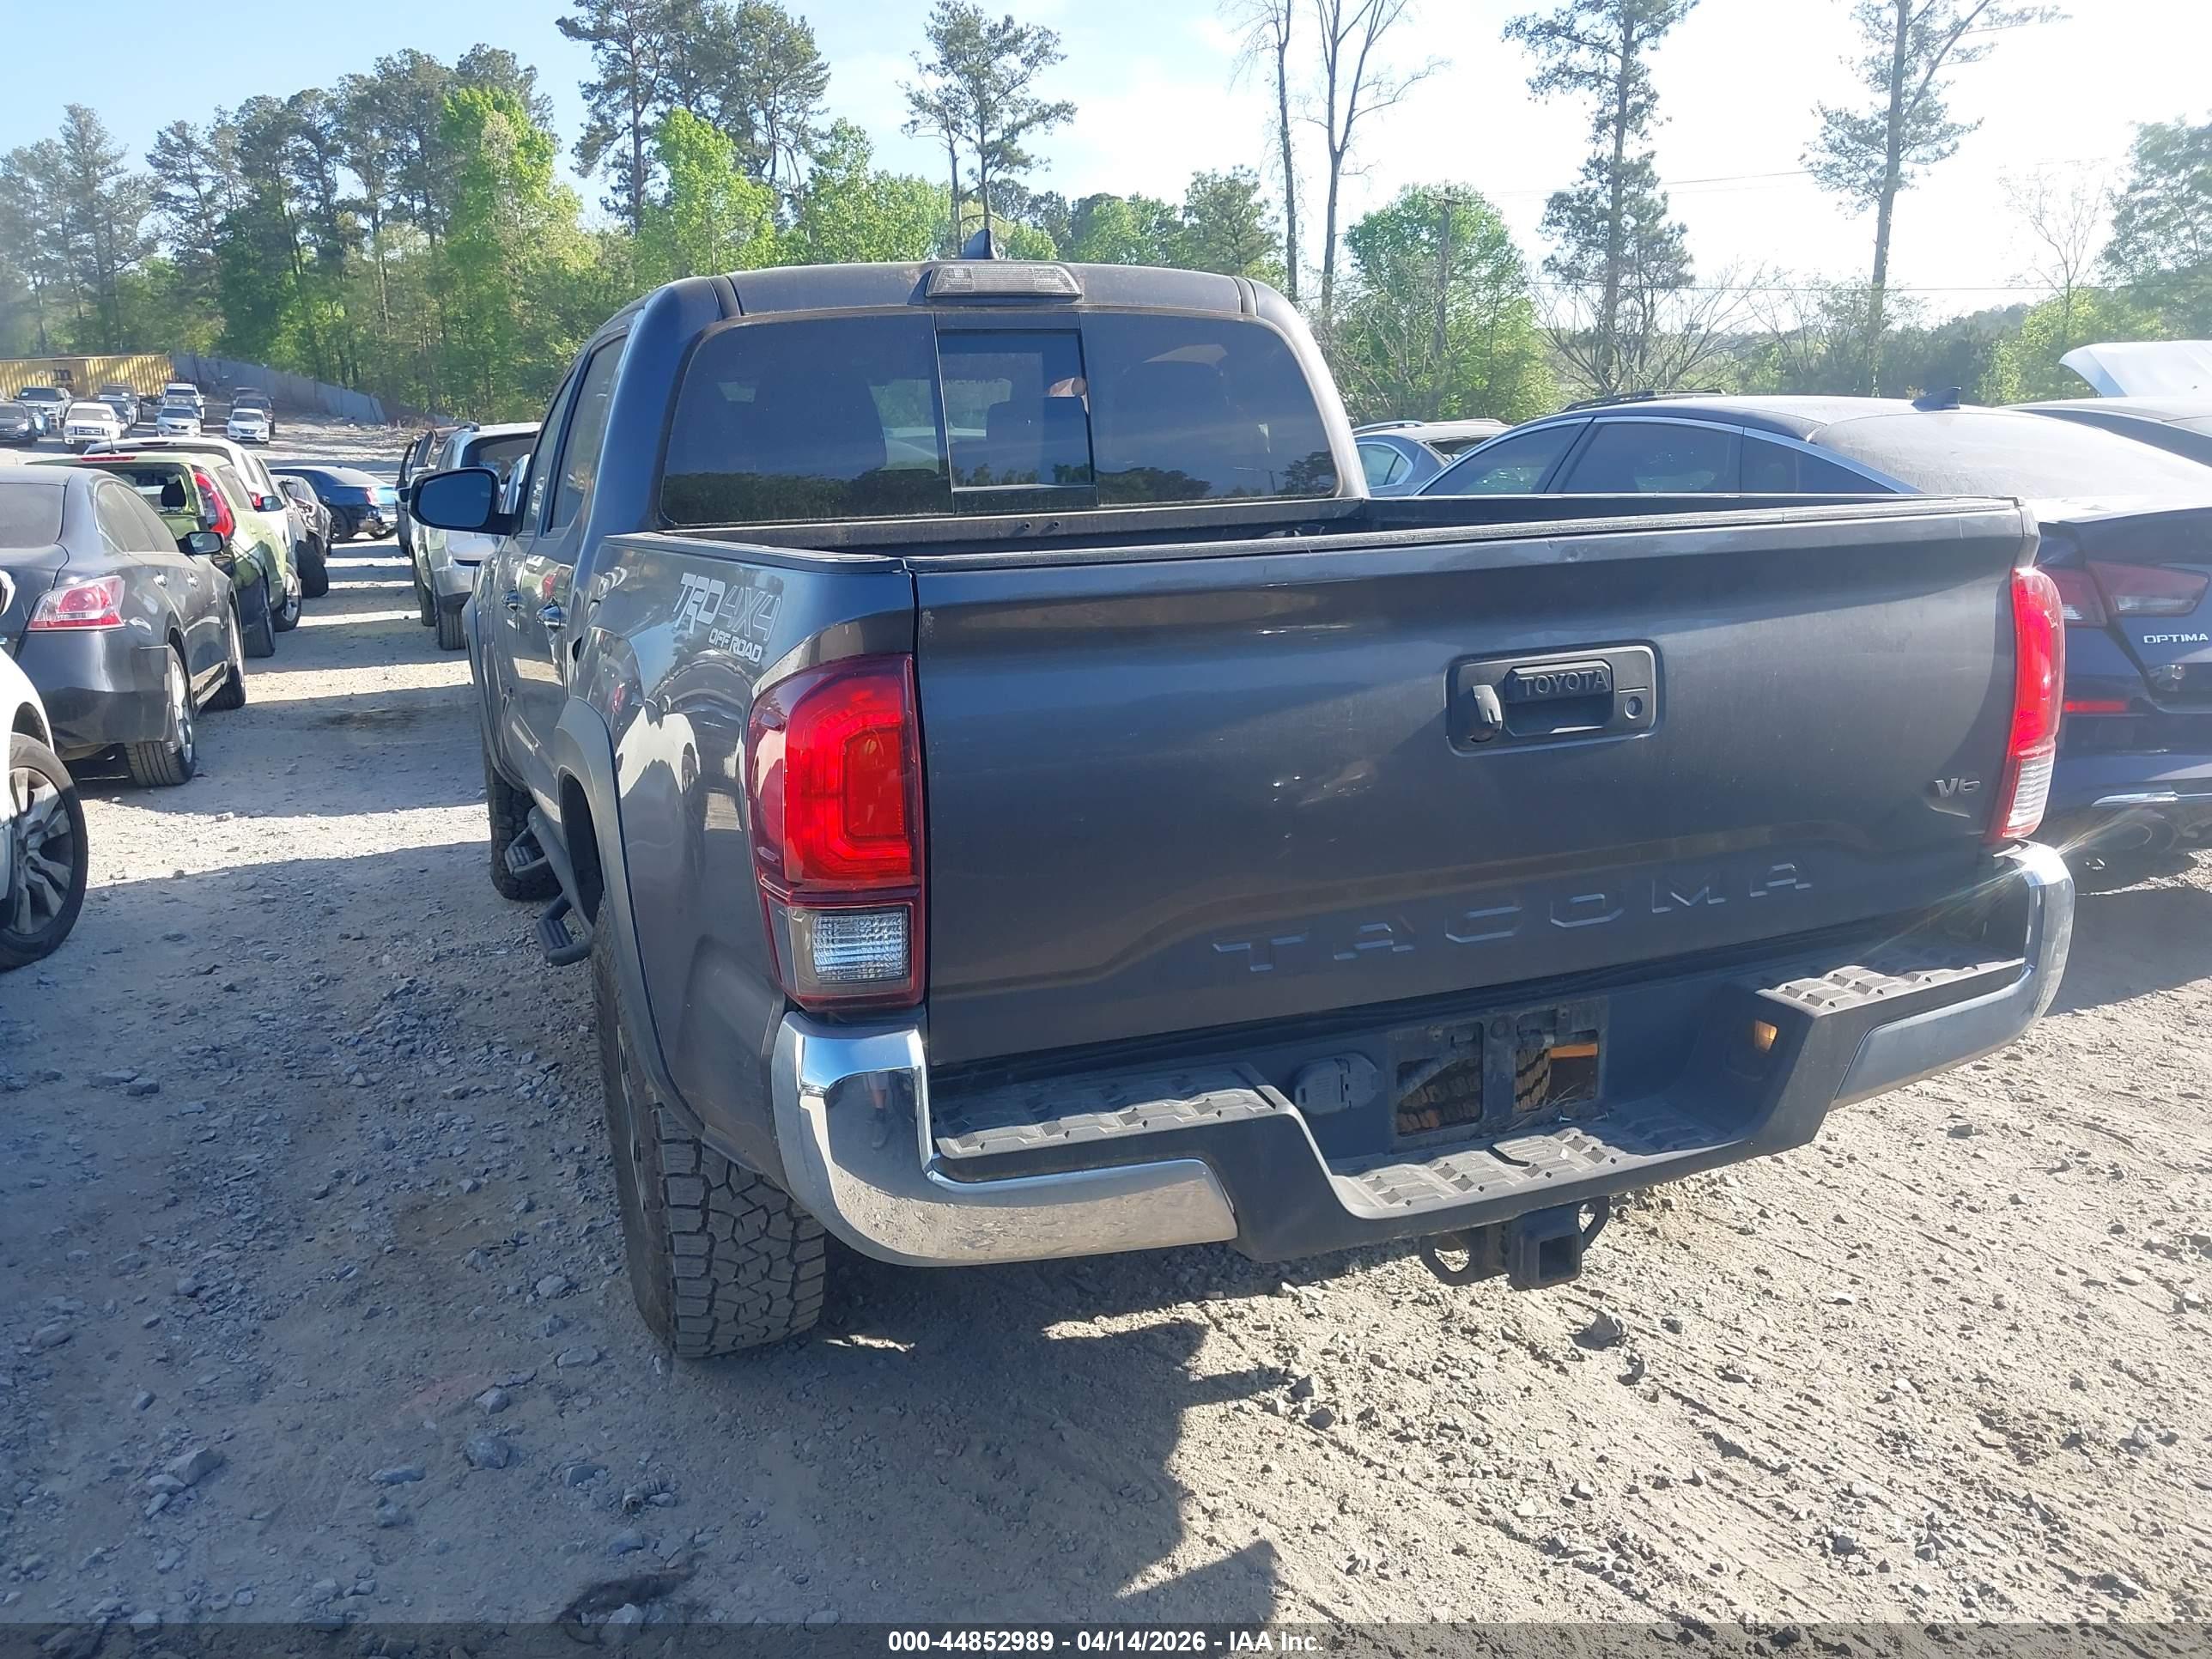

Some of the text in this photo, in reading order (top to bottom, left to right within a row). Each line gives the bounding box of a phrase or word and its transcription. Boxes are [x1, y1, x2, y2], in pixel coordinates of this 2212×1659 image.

[673, 573, 726, 634] TRD
[708, 629, 763, 663] OFF ROAD
[2143, 633, 2209, 645] OPTIMA
[1518, 670, 1611, 697] TOYOTA
[1934, 777, 1981, 798] V6
[1212, 861, 1811, 973] TACOMA
